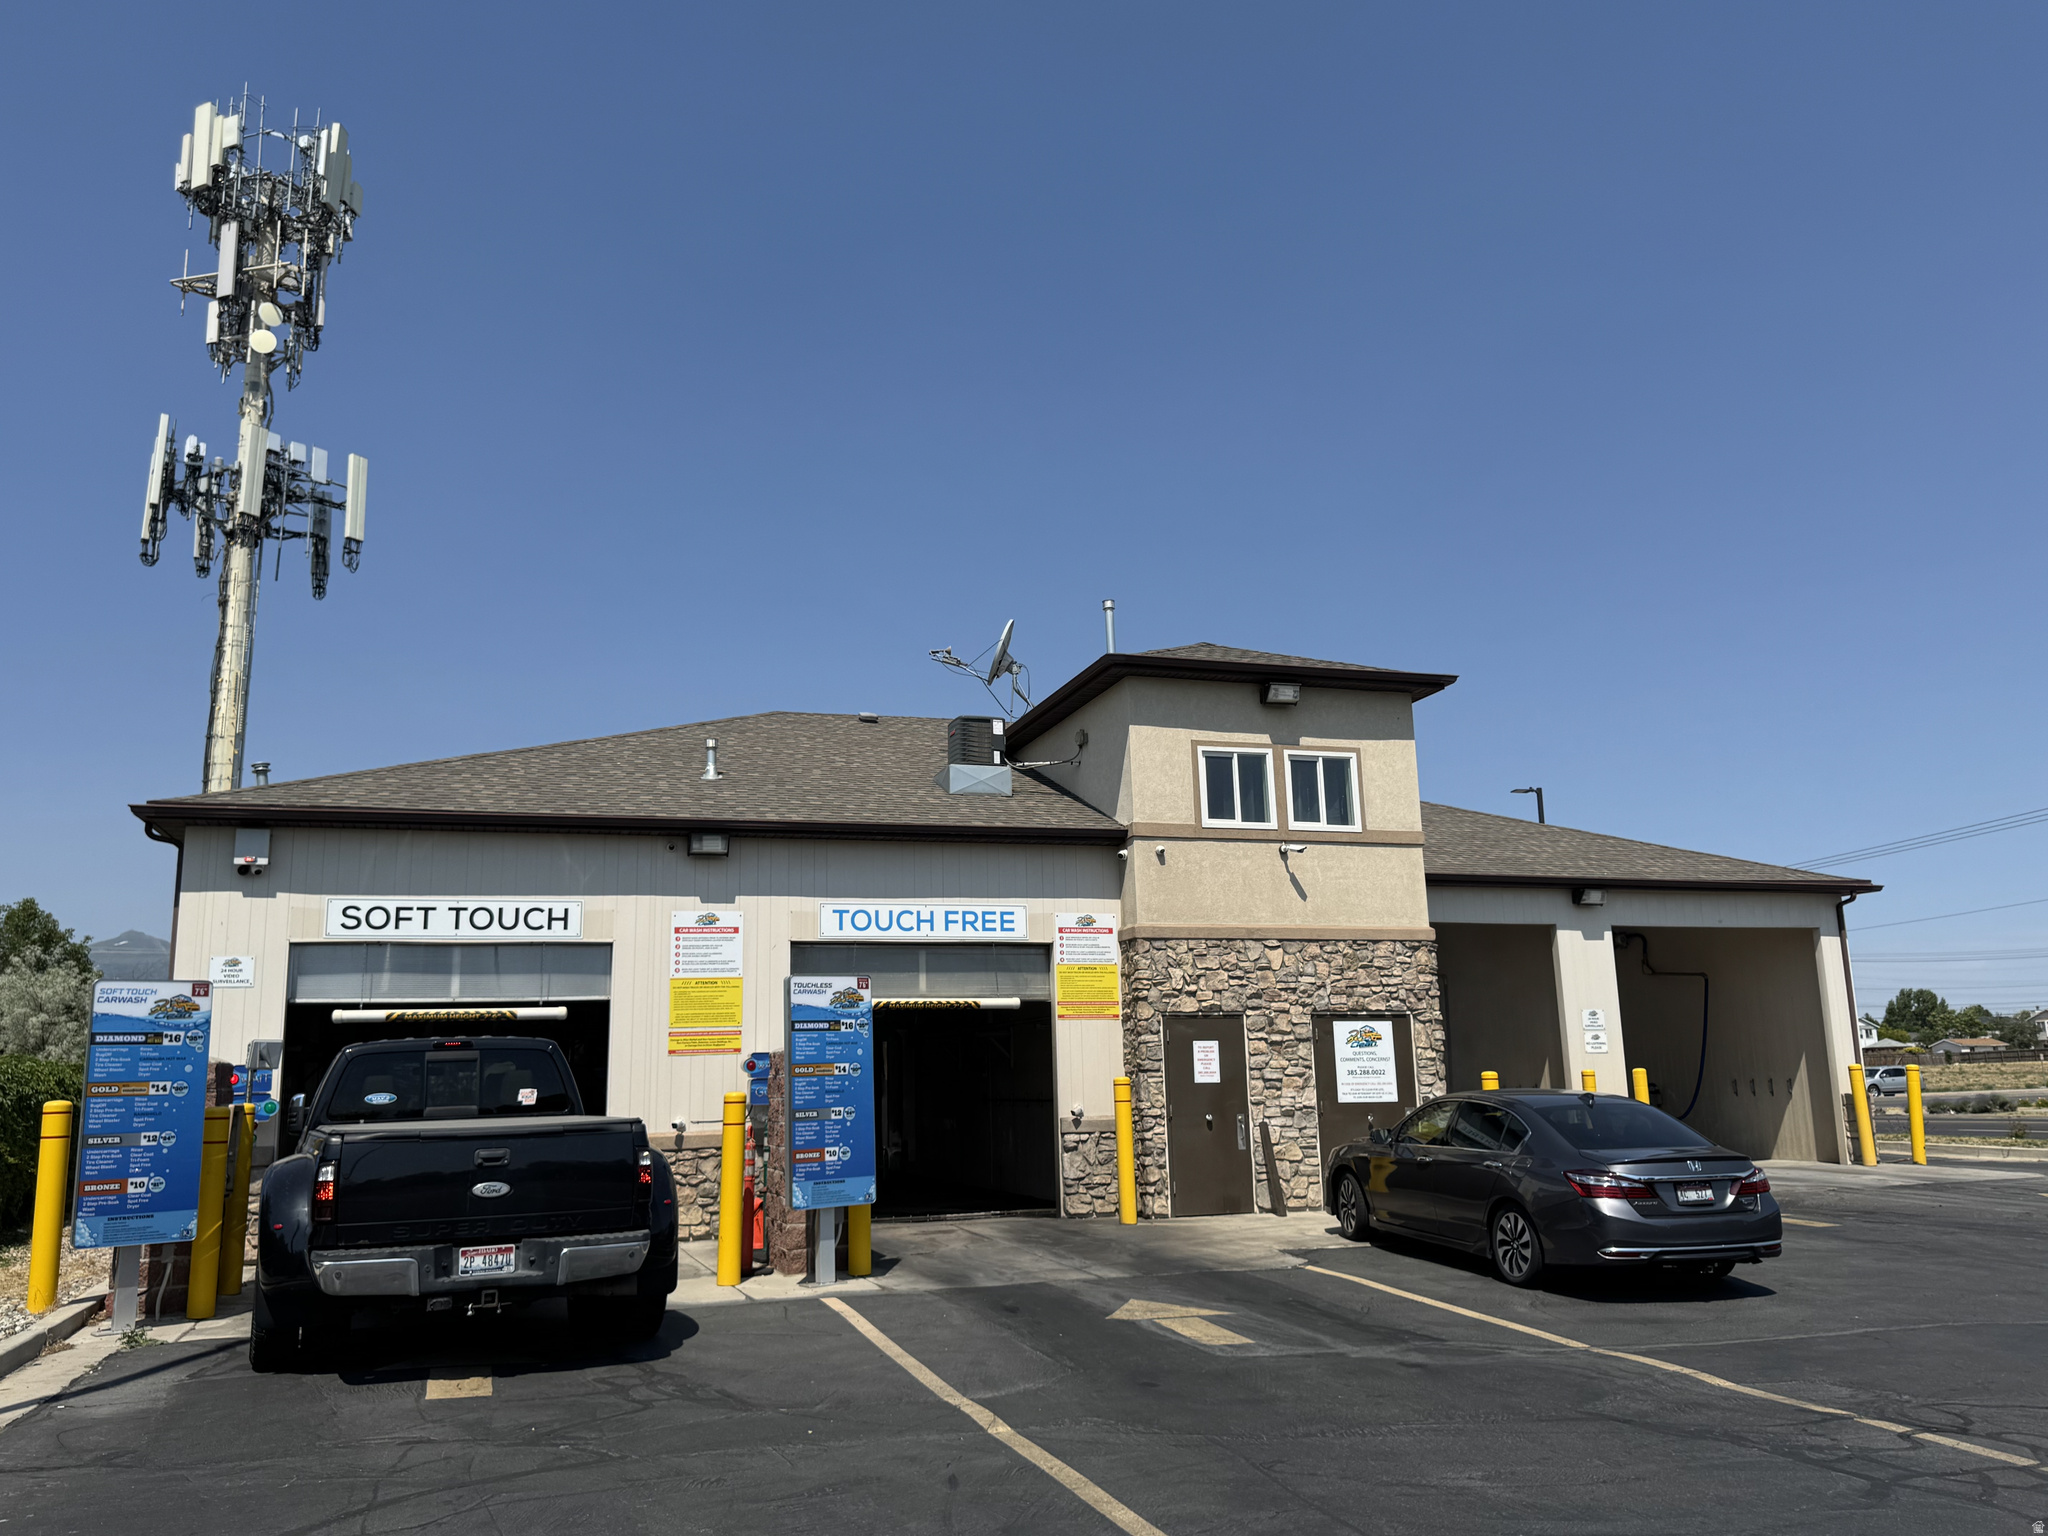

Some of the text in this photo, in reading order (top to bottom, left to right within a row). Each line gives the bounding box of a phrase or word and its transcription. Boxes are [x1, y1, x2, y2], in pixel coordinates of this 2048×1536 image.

[340, 905, 569, 931] SOFT TOUCH
[832, 909, 1015, 932] TOUCH FREE
[97, 996, 148, 1004] CARWASH
[841, 1022, 854, 1030] $16
[164, 1034, 182, 1043] $16
[835, 1065, 847, 1073] $14
[151, 1084, 168, 1092] $14
[84, 1183, 121, 1191] BRONZE
[130, 1181, 145, 1189] $10
[480, 1183, 503, 1194] Ford
[107, 1214, 154, 1222] INSTRUCTIONS
[393, 1216, 584, 1239] SUPER DUTY
[464, 1256, 475, 1268] 2P
[482, 1253, 511, 1267] 4847U
